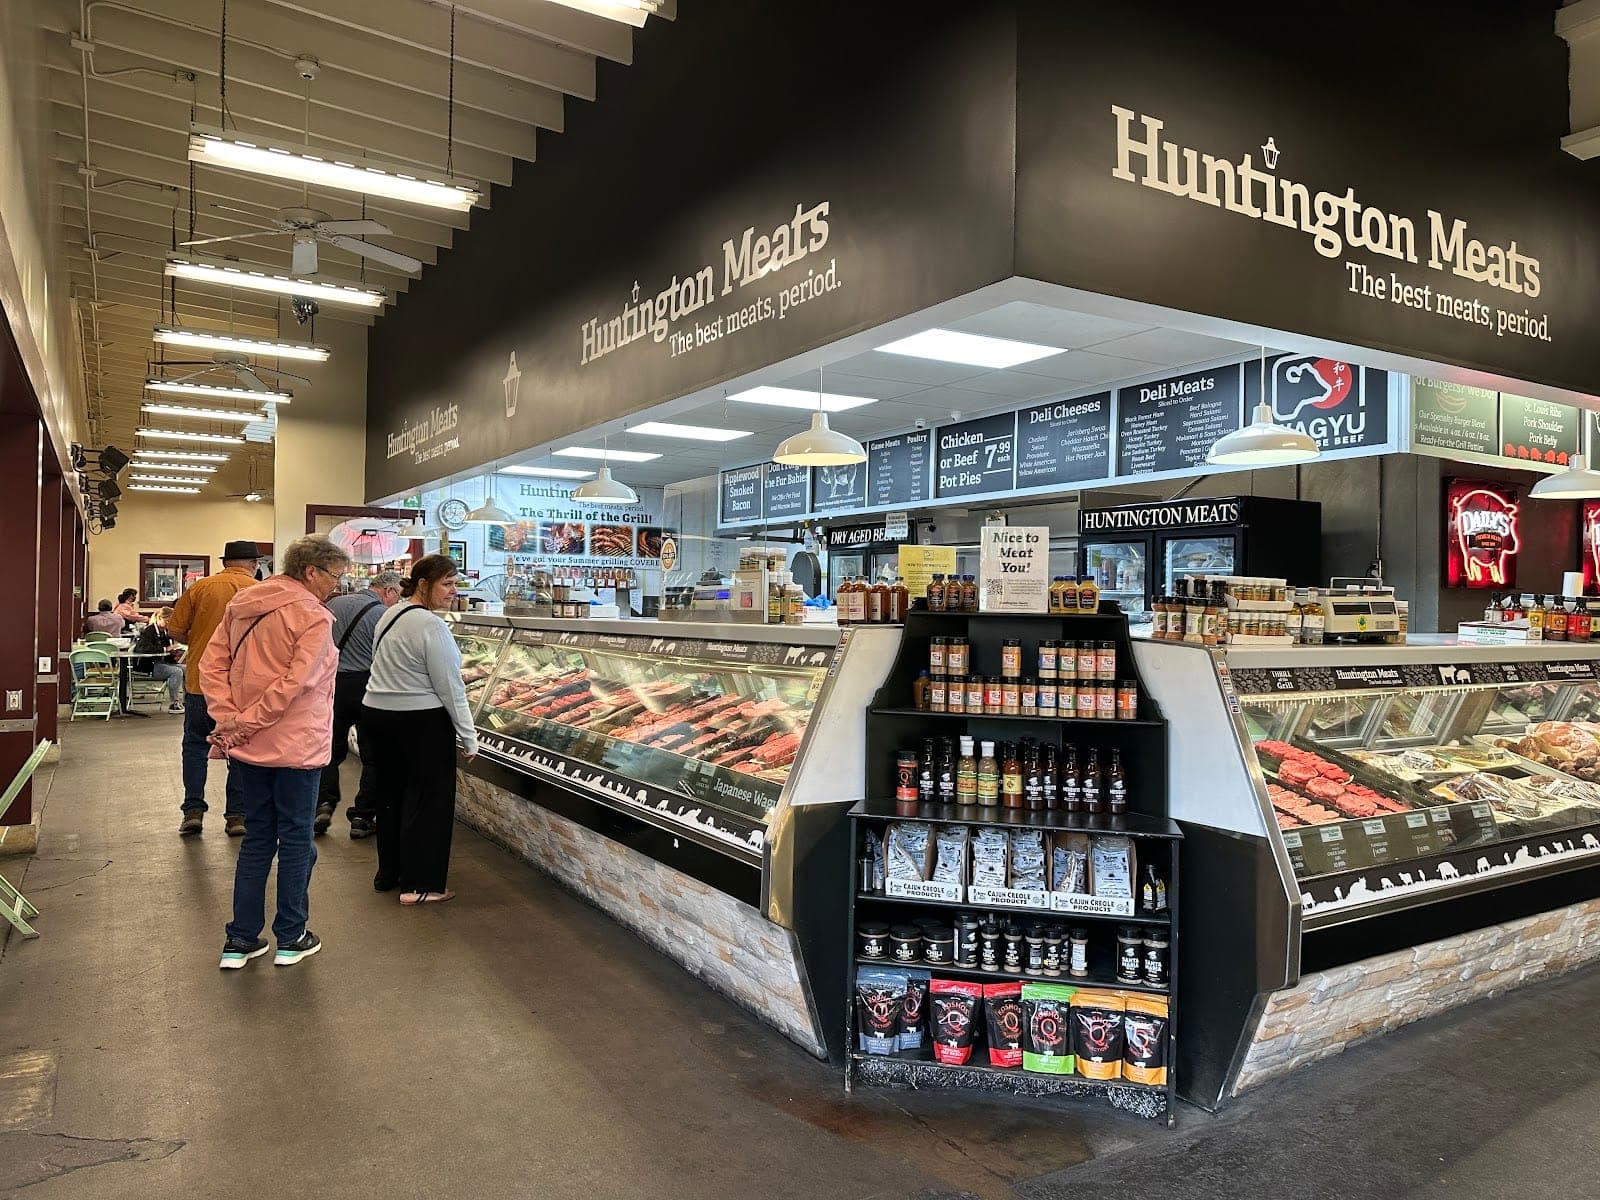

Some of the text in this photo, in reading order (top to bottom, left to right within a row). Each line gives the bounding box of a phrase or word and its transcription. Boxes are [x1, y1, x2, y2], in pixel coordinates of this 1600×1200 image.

[1112, 105, 1541, 297] Huntington Meats
[581, 201, 829, 365] Huntington Meats
[670, 260, 841, 358] The best meats, period.
[1346, 262, 1552, 342] The best meats, period.
[1333, 362, 1344, 391] 和牛
[1140, 377, 1215, 403] Deli Meats
[1030, 400, 1101, 424] Deli Cheeses
[1418, 410, 1430, 419] Our
[1533, 403, 1549, 416] Louis
[1549, 406, 1562, 418] Ribs
[387, 401, 458, 459] Huntington Meats
[1418, 422, 1444, 434] Available
[1523, 416, 1564, 433] Pork Shoulder
[906, 434, 928, 444] Poultry
[941, 431, 984, 450] Chicken
[1334, 434, 1364, 446] BEEF
[1455, 440, 1467, 449] Grill
[1528, 431, 1559, 449] Pork Belly
[870, 442, 885, 451] Game
[940, 450, 979, 470] or Beef
[997, 454, 1011, 463] each
[724, 468, 759, 486] Applewood
[764, 471, 809, 489] the Fur Babies
[939, 471, 982, 489] Pot Pies
[730, 483, 754, 498] Smoked
[732, 500, 751, 512] Bacon
[519, 507, 652, 524] The Thrill of the Grill!
[1084, 502, 1240, 529] HUNTINGTON MEATS
[831, 529, 872, 545] DRY AGED
[992, 532, 1040, 543] Nice to
[998, 547, 1034, 558] Meat
[568, 556, 599, 564] Summer
[601, 559, 628, 567] grilling
[629, 558, 660, 567] COVERE
[1001, 562, 1031, 573] You!
[1270, 670, 1293, 678] THRILL
[1335, 668, 1399, 682] Huntington Meats
[1276, 681, 1295, 690] Grill
[713, 778, 752, 802] Japanese
[903, 883, 945, 894] CAJUN CREOLE
[906, 890, 942, 898] PRODUCTS
[987, 890, 1031, 901] CAJUN CREOLE
[990, 897, 1028, 905] PRODUCTS
[1069, 897, 1115, 908] CAJUN CREOLE
[1073, 904, 1111, 913] PRODUCTS
[865, 944, 883, 952] CHILI
[1040, 1018, 1057, 1040] Q
